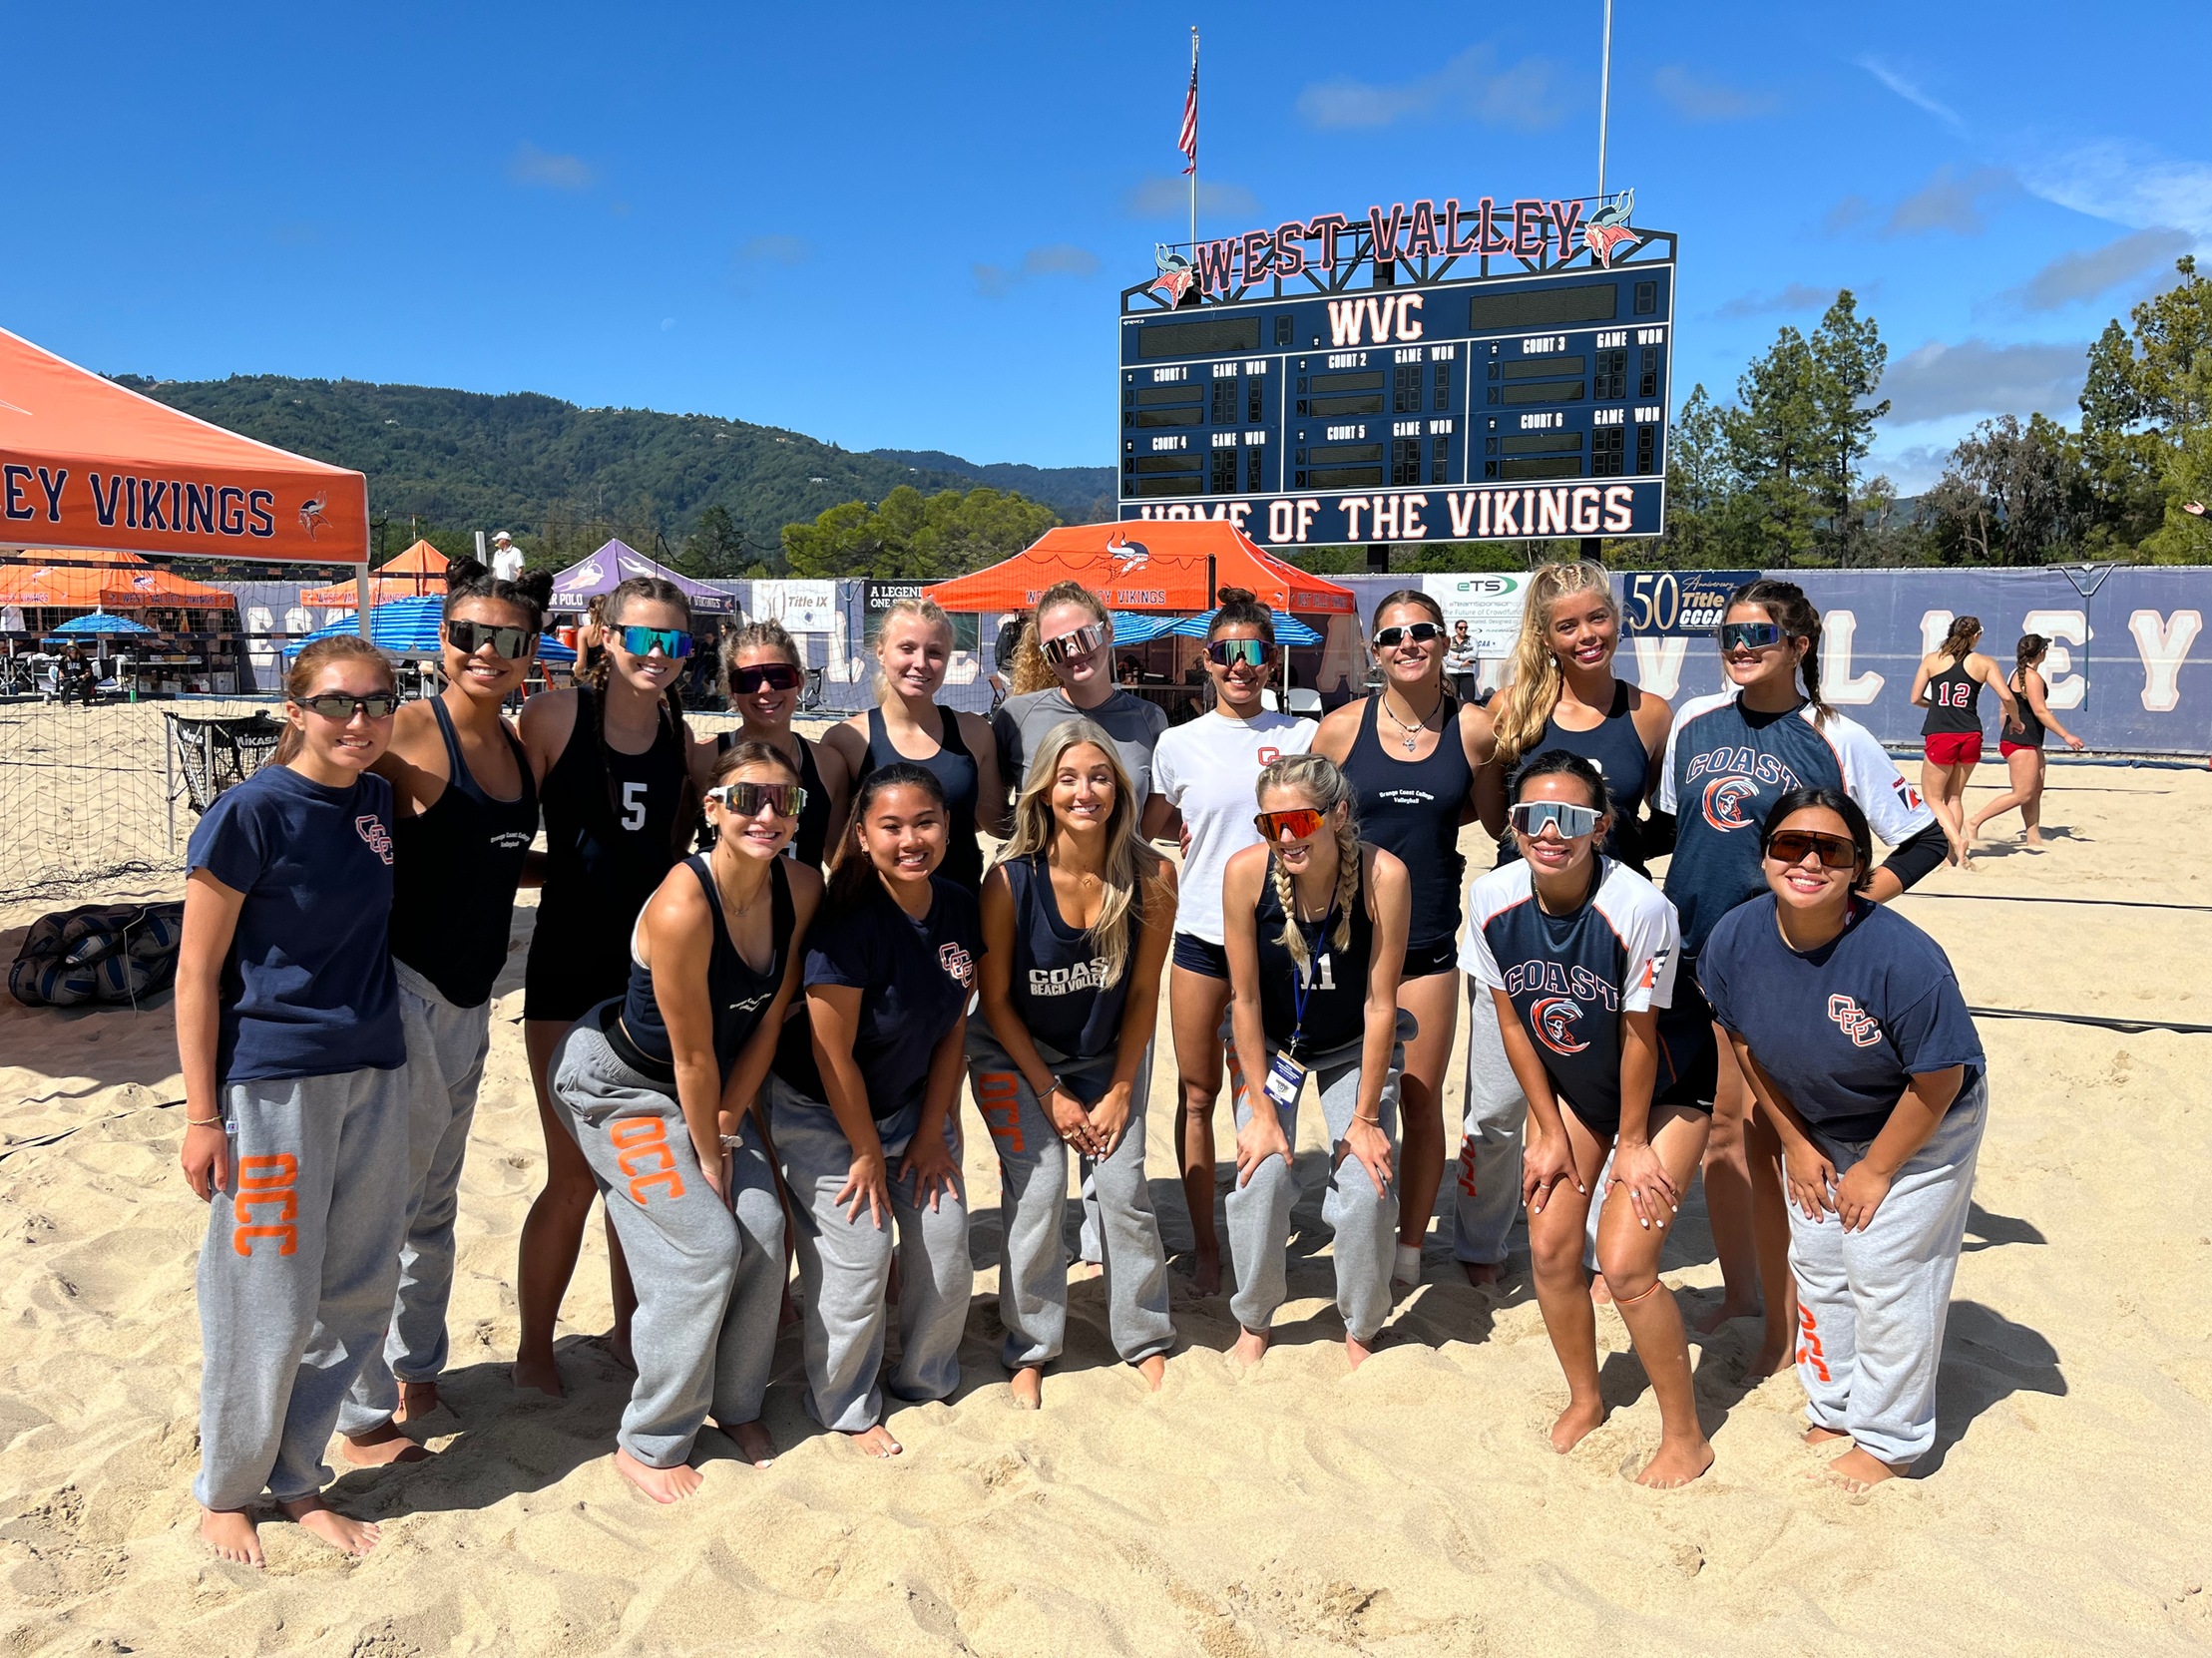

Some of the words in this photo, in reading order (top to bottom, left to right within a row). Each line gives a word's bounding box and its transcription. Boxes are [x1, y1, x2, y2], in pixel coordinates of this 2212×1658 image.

[1197, 212, 1348, 296] WEST
[1370, 197, 1584, 264] VALLEY
[1328, 293, 1424, 346] WVC
[1523, 337, 1554, 354] COURT
[1558, 336, 1565, 351] 3
[1596, 331, 1627, 348] GAME
[1637, 328, 1663, 345] WON
[1328, 353, 1357, 369] COURT
[1360, 352, 1367, 366] 2
[1395, 348, 1422, 363] GAME
[1431, 345, 1455, 361] WON
[1153, 367, 1179, 382] COURT
[1182, 366, 1187, 380] 1
[1212, 363, 1237, 378] GAME
[1246, 360, 1267, 376] WON
[1521, 413, 1552, 429] COURT
[1555, 412, 1562, 427] 6
[1594, 409, 1624, 425] GAME
[1634, 407, 1659, 423] WON
[1327, 426, 1356, 440] COURT
[1359, 425, 1365, 439] 5
[1393, 421, 1420, 436] GAME
[1430, 419, 1453, 434] WON
[1152, 436, 1178, 451] COURT
[1180, 436, 1187, 449] 4
[1212, 432, 1237, 447] GAME
[1245, 431, 1266, 446] WON
[2, 463, 69, 522] EY
[89, 473, 275, 539] VIKINGS
[1268, 498, 1320, 544] OF
[1339, 494, 1429, 540] THE
[1447, 485, 1633, 538] VIKINGS
[870, 587, 879, 598] A
[1457, 581, 1501, 592] eTS
[559, 594, 583, 606] POLO
[788, 597, 813, 608] Title
[816, 597, 828, 608] IX
[1117, 591, 1165, 604] VIKINGS
[1630, 574, 1678, 630] 50
[1682, 574, 1739, 592] Anniversary
[1681, 592, 1724, 608] Title
[1939, 680, 1971, 708] 12
[621, 781, 648, 831] 5
[1029, 956, 1109, 985] COAS
[1031, 982, 1066, 996] BEACH
[1504, 959, 1618, 1012] COAST
[609, 1115, 686, 1205] OCC
[233, 1152, 298, 1257] OCC
